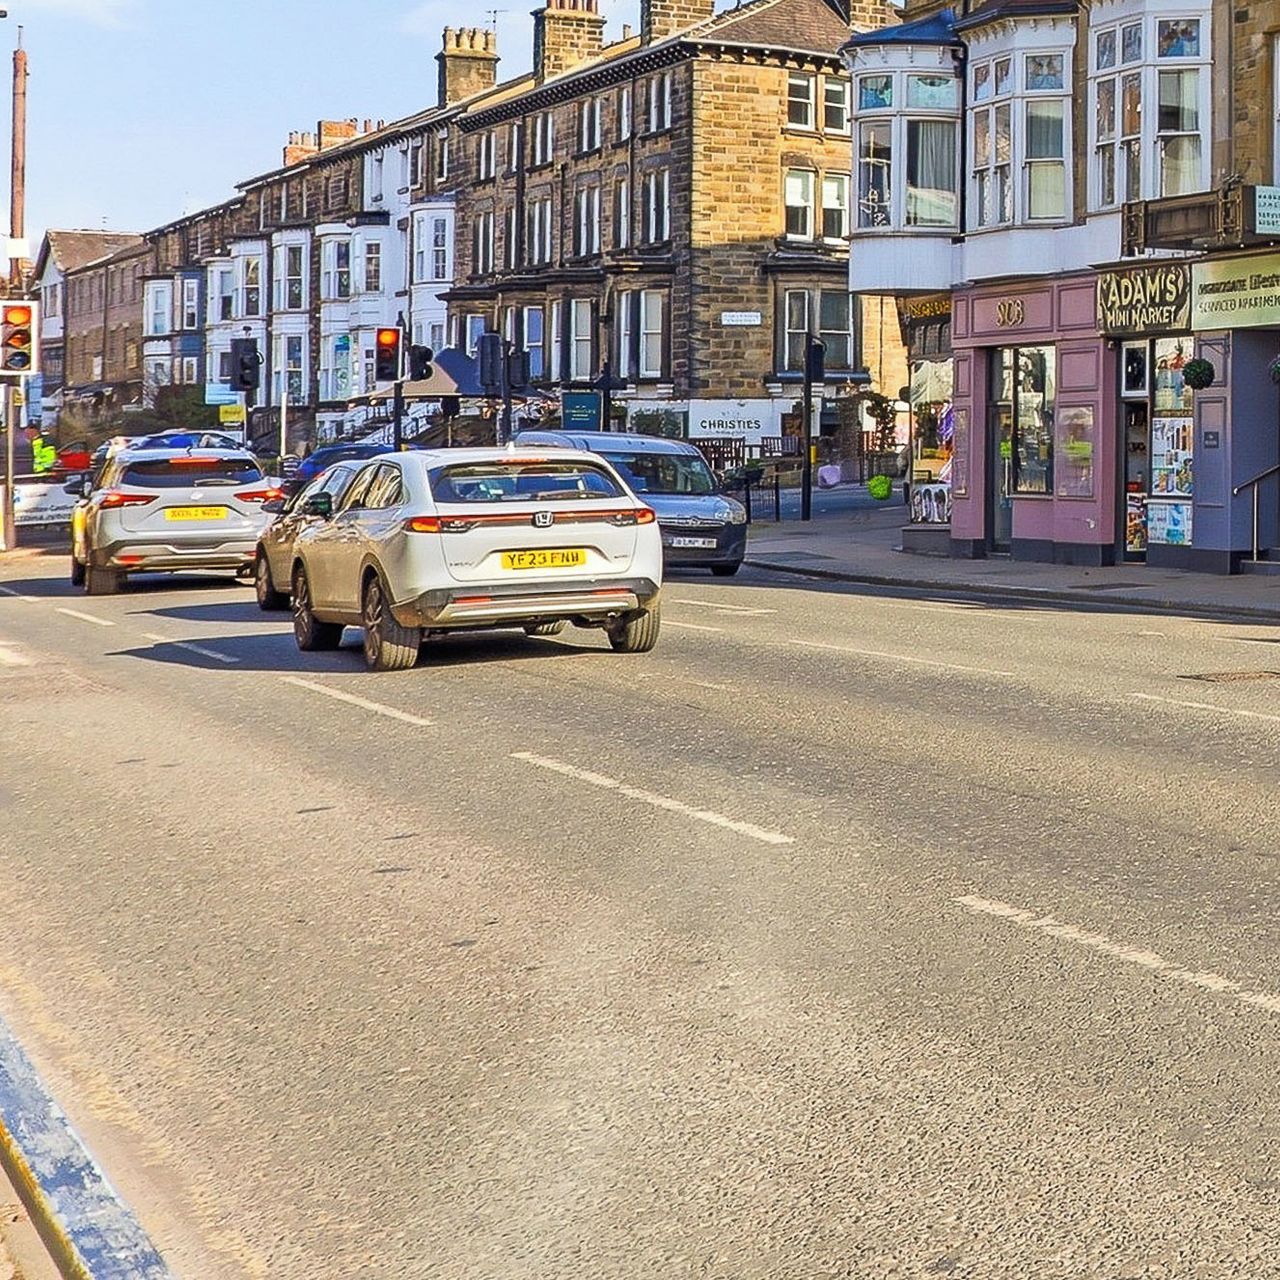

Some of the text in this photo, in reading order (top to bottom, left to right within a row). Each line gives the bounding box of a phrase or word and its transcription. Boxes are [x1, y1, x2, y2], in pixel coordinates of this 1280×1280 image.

[1107, 271, 1177, 308] ADAM'S
[1107, 305, 1176, 330] MINI MARKET
[700, 420, 761, 430] CHRISTIES
